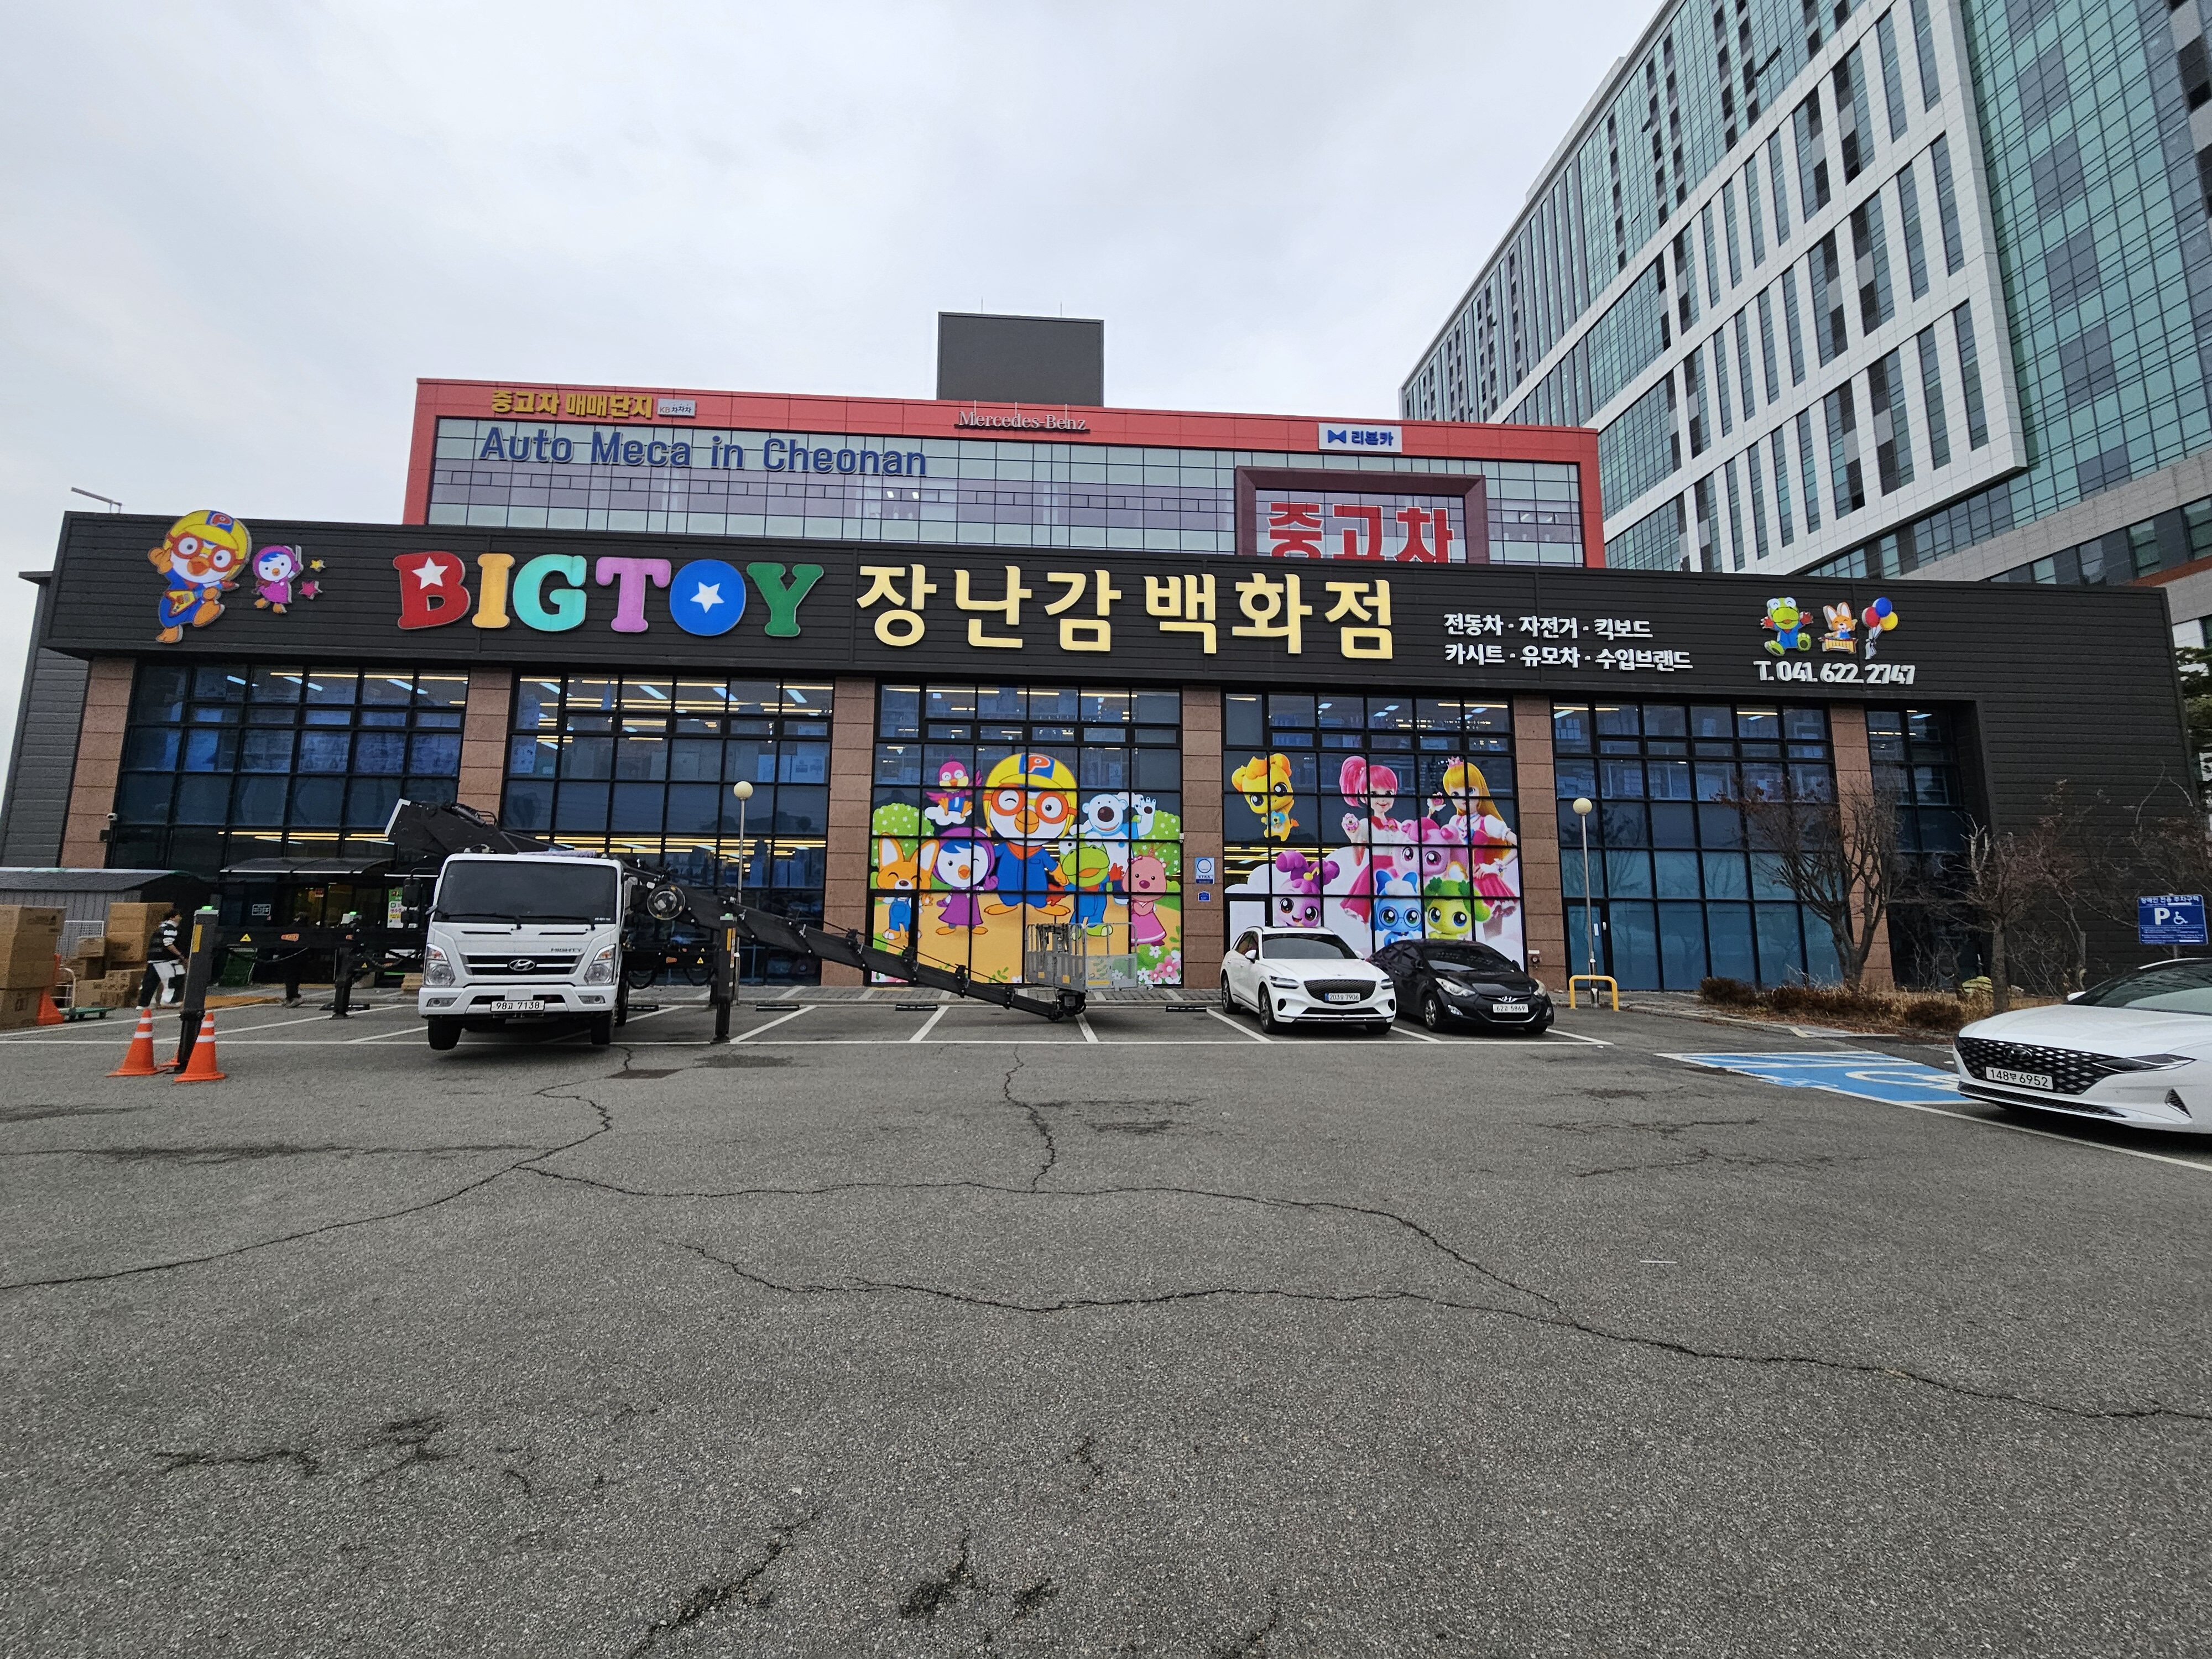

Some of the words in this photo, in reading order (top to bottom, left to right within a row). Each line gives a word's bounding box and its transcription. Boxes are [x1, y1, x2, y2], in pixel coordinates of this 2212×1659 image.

[491, 389, 560, 415] 중고차
[566, 393, 654, 419] 매매단지
[958, 411, 1087, 430] Mercedes-Benz
[479, 426, 574, 463] Auto
[591, 431, 692, 467] Meca
[711, 435, 745, 472] in
[763, 437, 927, 477] Cheonan
[1351, 430, 1394, 446] 리본카
[1267, 502, 1454, 563] 중고차
[392, 551, 825, 638] BIGTOY
[856, 564, 1122, 652] 장난감
[1144, 572, 1394, 660] 백화점
[1443, 612, 1504, 636] 전동차
[1519, 615, 1578, 639] 자전거
[1594, 618, 1653, 641] 킥보드
[1444, 643, 1505, 665] 카시트
[1520, 645, 1580, 668] 유모차
[1595, 648, 1693, 672] 수입브랜드
[2154, 907, 2171, 925] P
[517, 1001, 540, 1010] 7138
[1990, 1069, 2017, 1082] 148부
[2019, 1073, 2049, 1088] 6952
